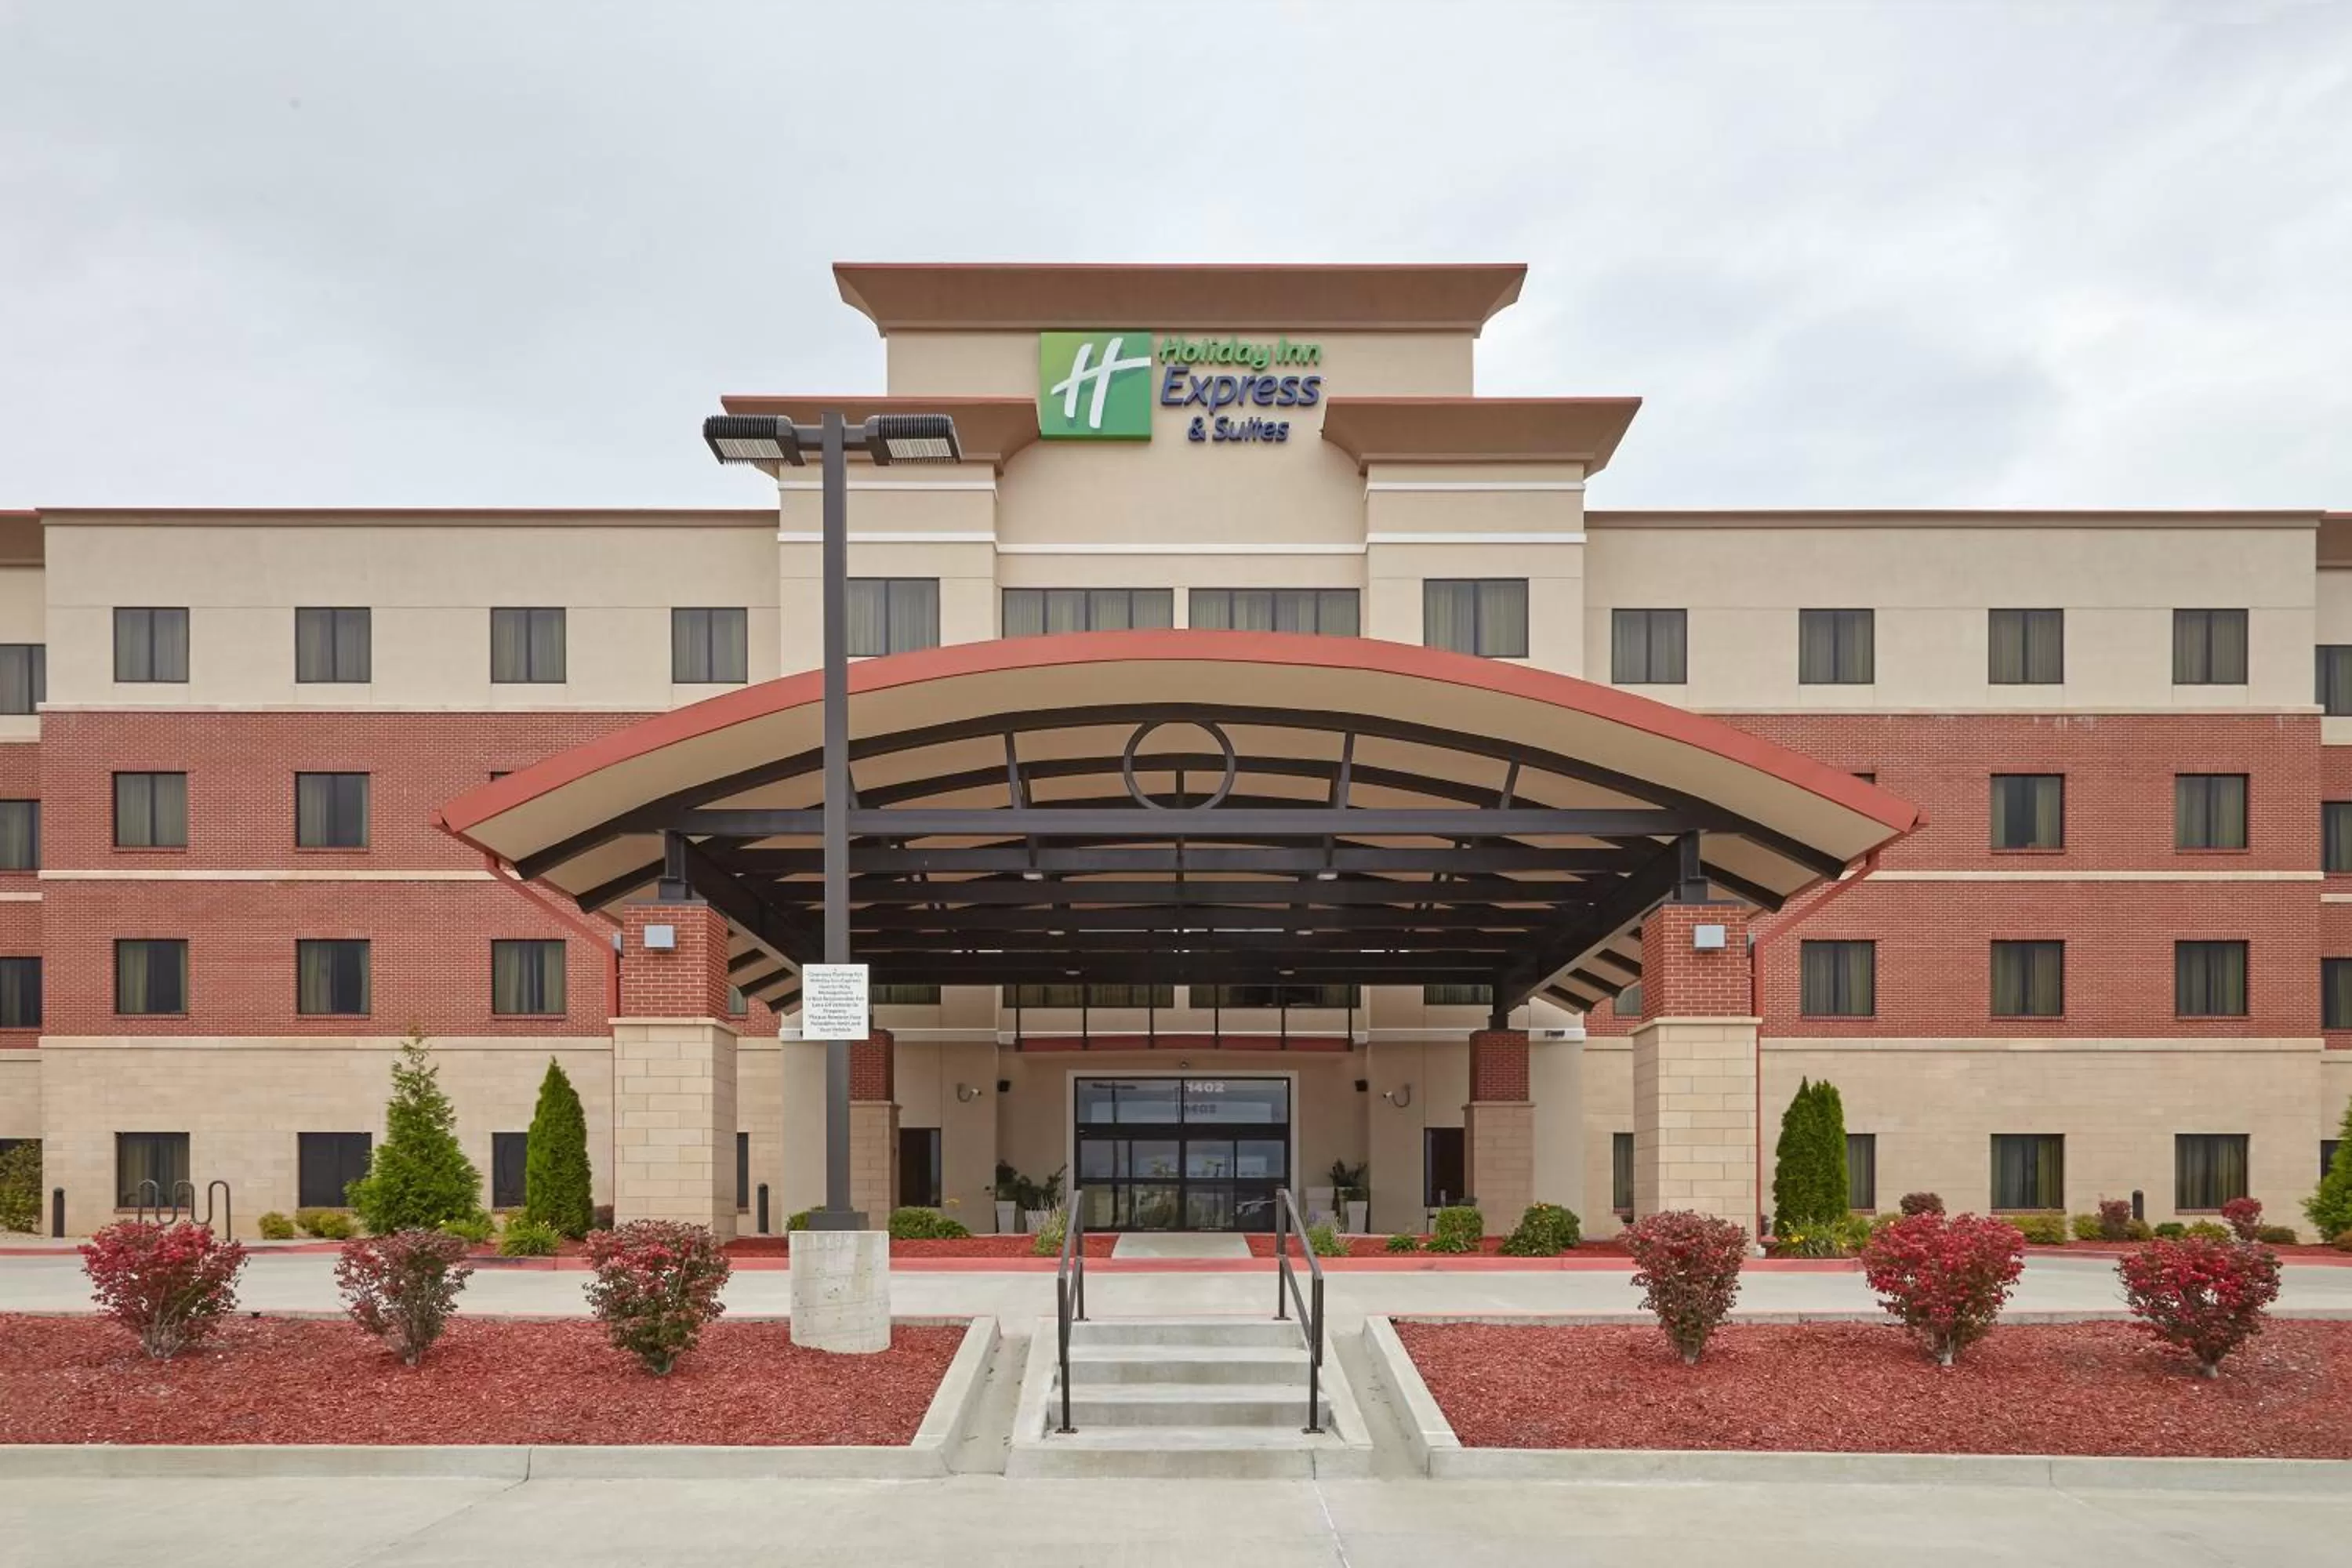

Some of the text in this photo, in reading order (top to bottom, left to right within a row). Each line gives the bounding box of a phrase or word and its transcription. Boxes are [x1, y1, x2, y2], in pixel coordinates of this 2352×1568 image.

[1159, 334, 1323, 372] Holiday Inn
[1160, 365, 1321, 416] Express
[1188, 416, 1290, 441] & Suites
[1187, 1082, 1225, 1092] 1402
